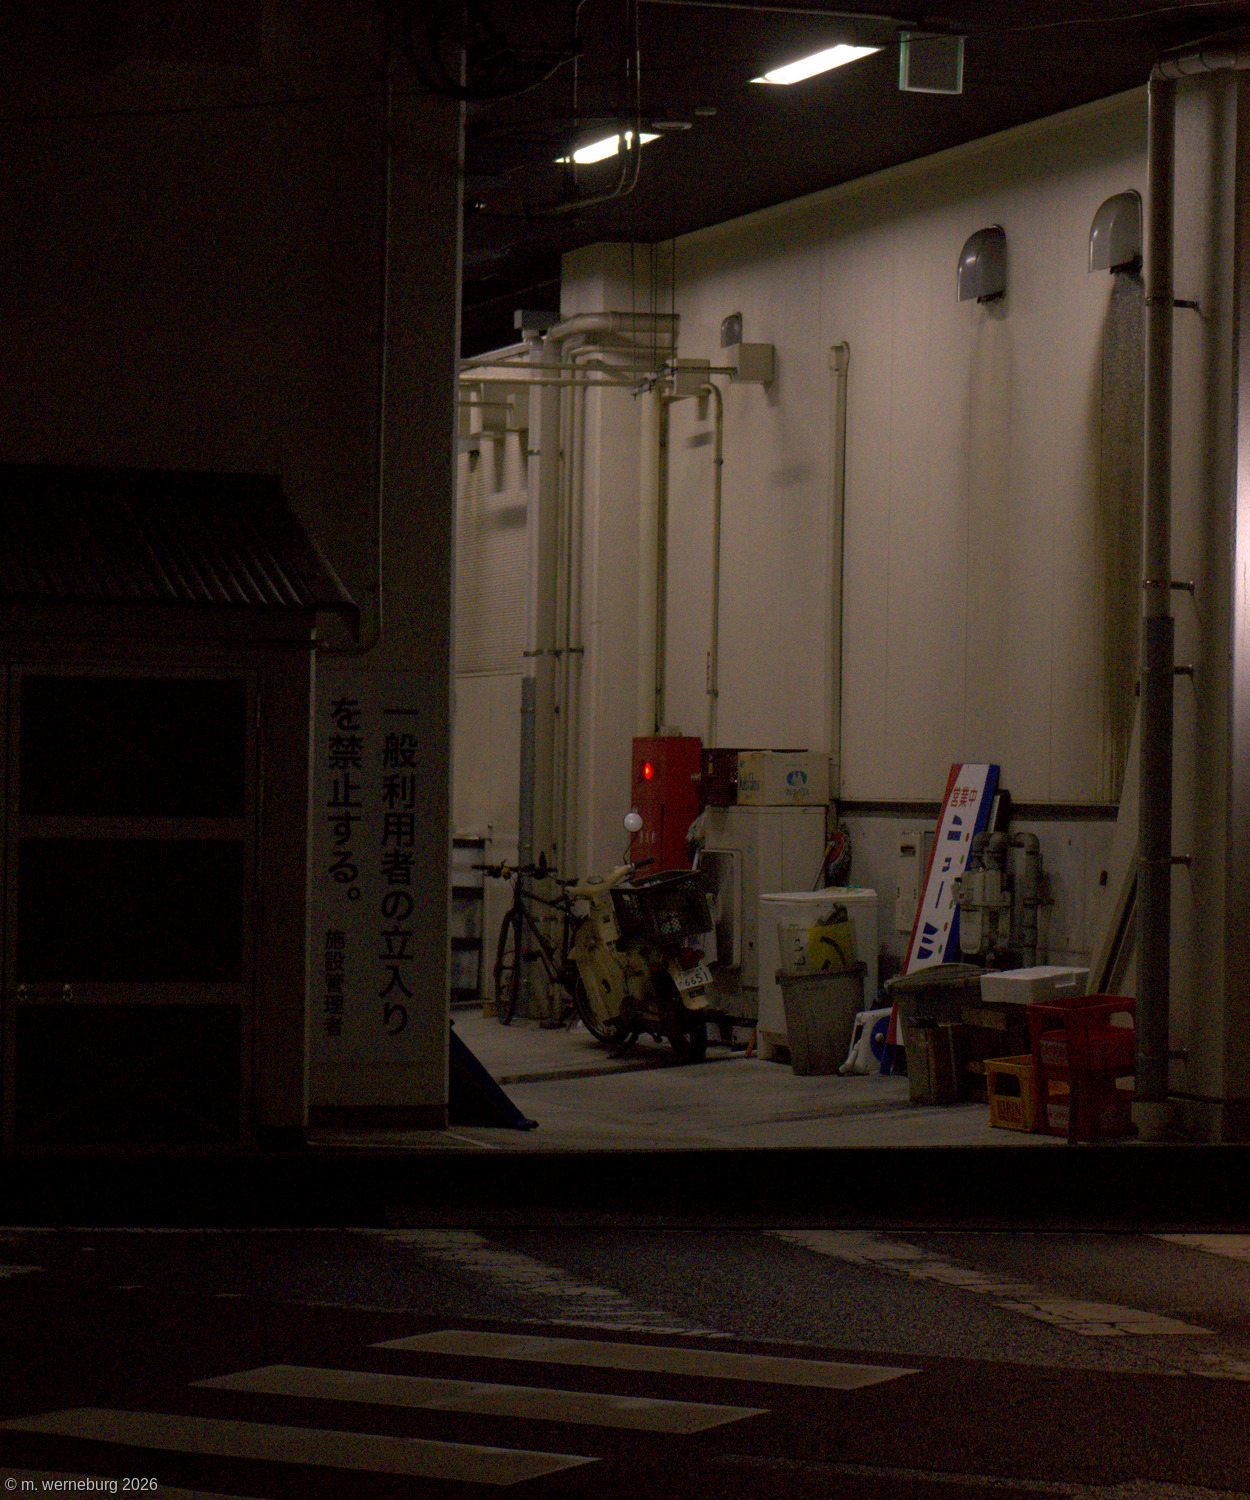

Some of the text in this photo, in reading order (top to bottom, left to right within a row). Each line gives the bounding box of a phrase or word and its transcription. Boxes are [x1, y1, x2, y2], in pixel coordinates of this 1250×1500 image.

[327, 697, 363, 901] を禁止する。
[379, 707, 419, 1037] 一般利用者の立入り
[917, 814, 963, 960] ニューミ
[324, 929, 346, 1037] 施設管理者
